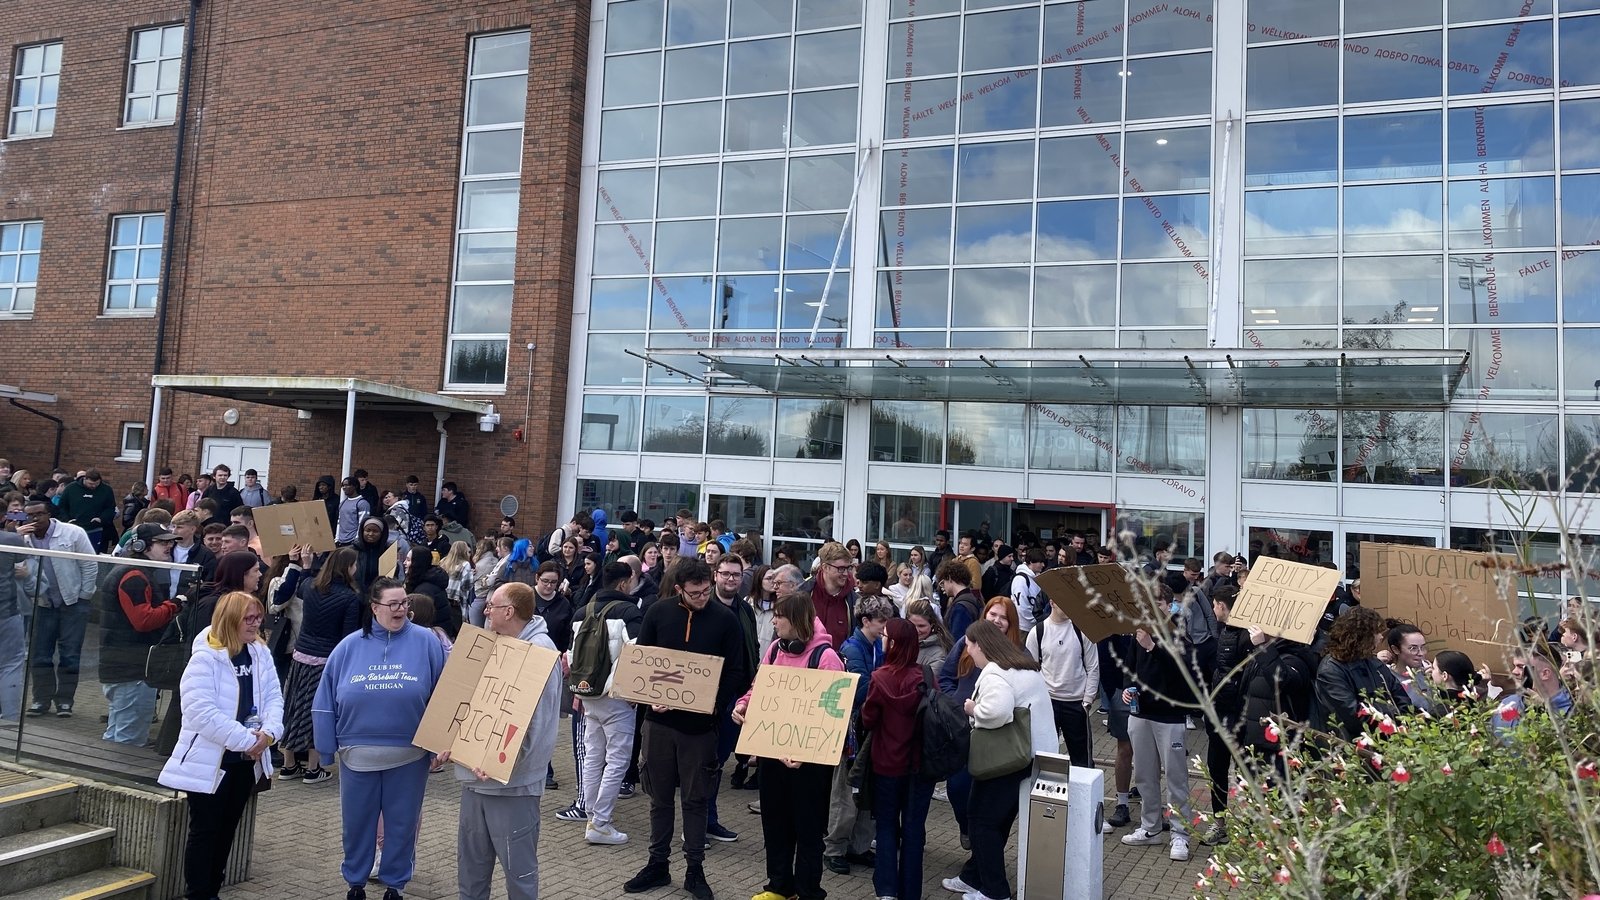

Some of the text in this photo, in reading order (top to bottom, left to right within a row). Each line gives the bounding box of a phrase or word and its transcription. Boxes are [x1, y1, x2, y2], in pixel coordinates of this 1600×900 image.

[978, 76, 1011, 96] WELKOM
[1066, 30, 1109, 56] BIENVENUE
[1173, 6, 1200, 20] ALOHA
[1374, 48, 1480, 75] ДОБРО ПОЖАОВАТЬ
[900, 163, 908, 188] ALOHA
[627, 234, 645, 259] WELKOM
[666, 296, 688, 329] BIENVENUE
[1486, 267, 1499, 317] BIENVENUE
[734, 335, 756, 343] ALOHA
[1257, 562, 1327, 590] EQUITY
[1274, 589, 1285, 598] IN
[1416, 580, 1467, 611] NOT
[1230, 589, 1313, 630] LEARNING
[466, 634, 515, 670] EAT
[350, 672, 418, 684] Elite Baseball Team
[633, 676, 695, 704] 2500
[767, 672, 821, 693] SHOW
[481, 675, 521, 716] THE
[760, 696, 779, 712] US
[792, 697, 818, 716] THE
[447, 701, 519, 764] RICH!
[748, 720, 842, 754] MONEY!
